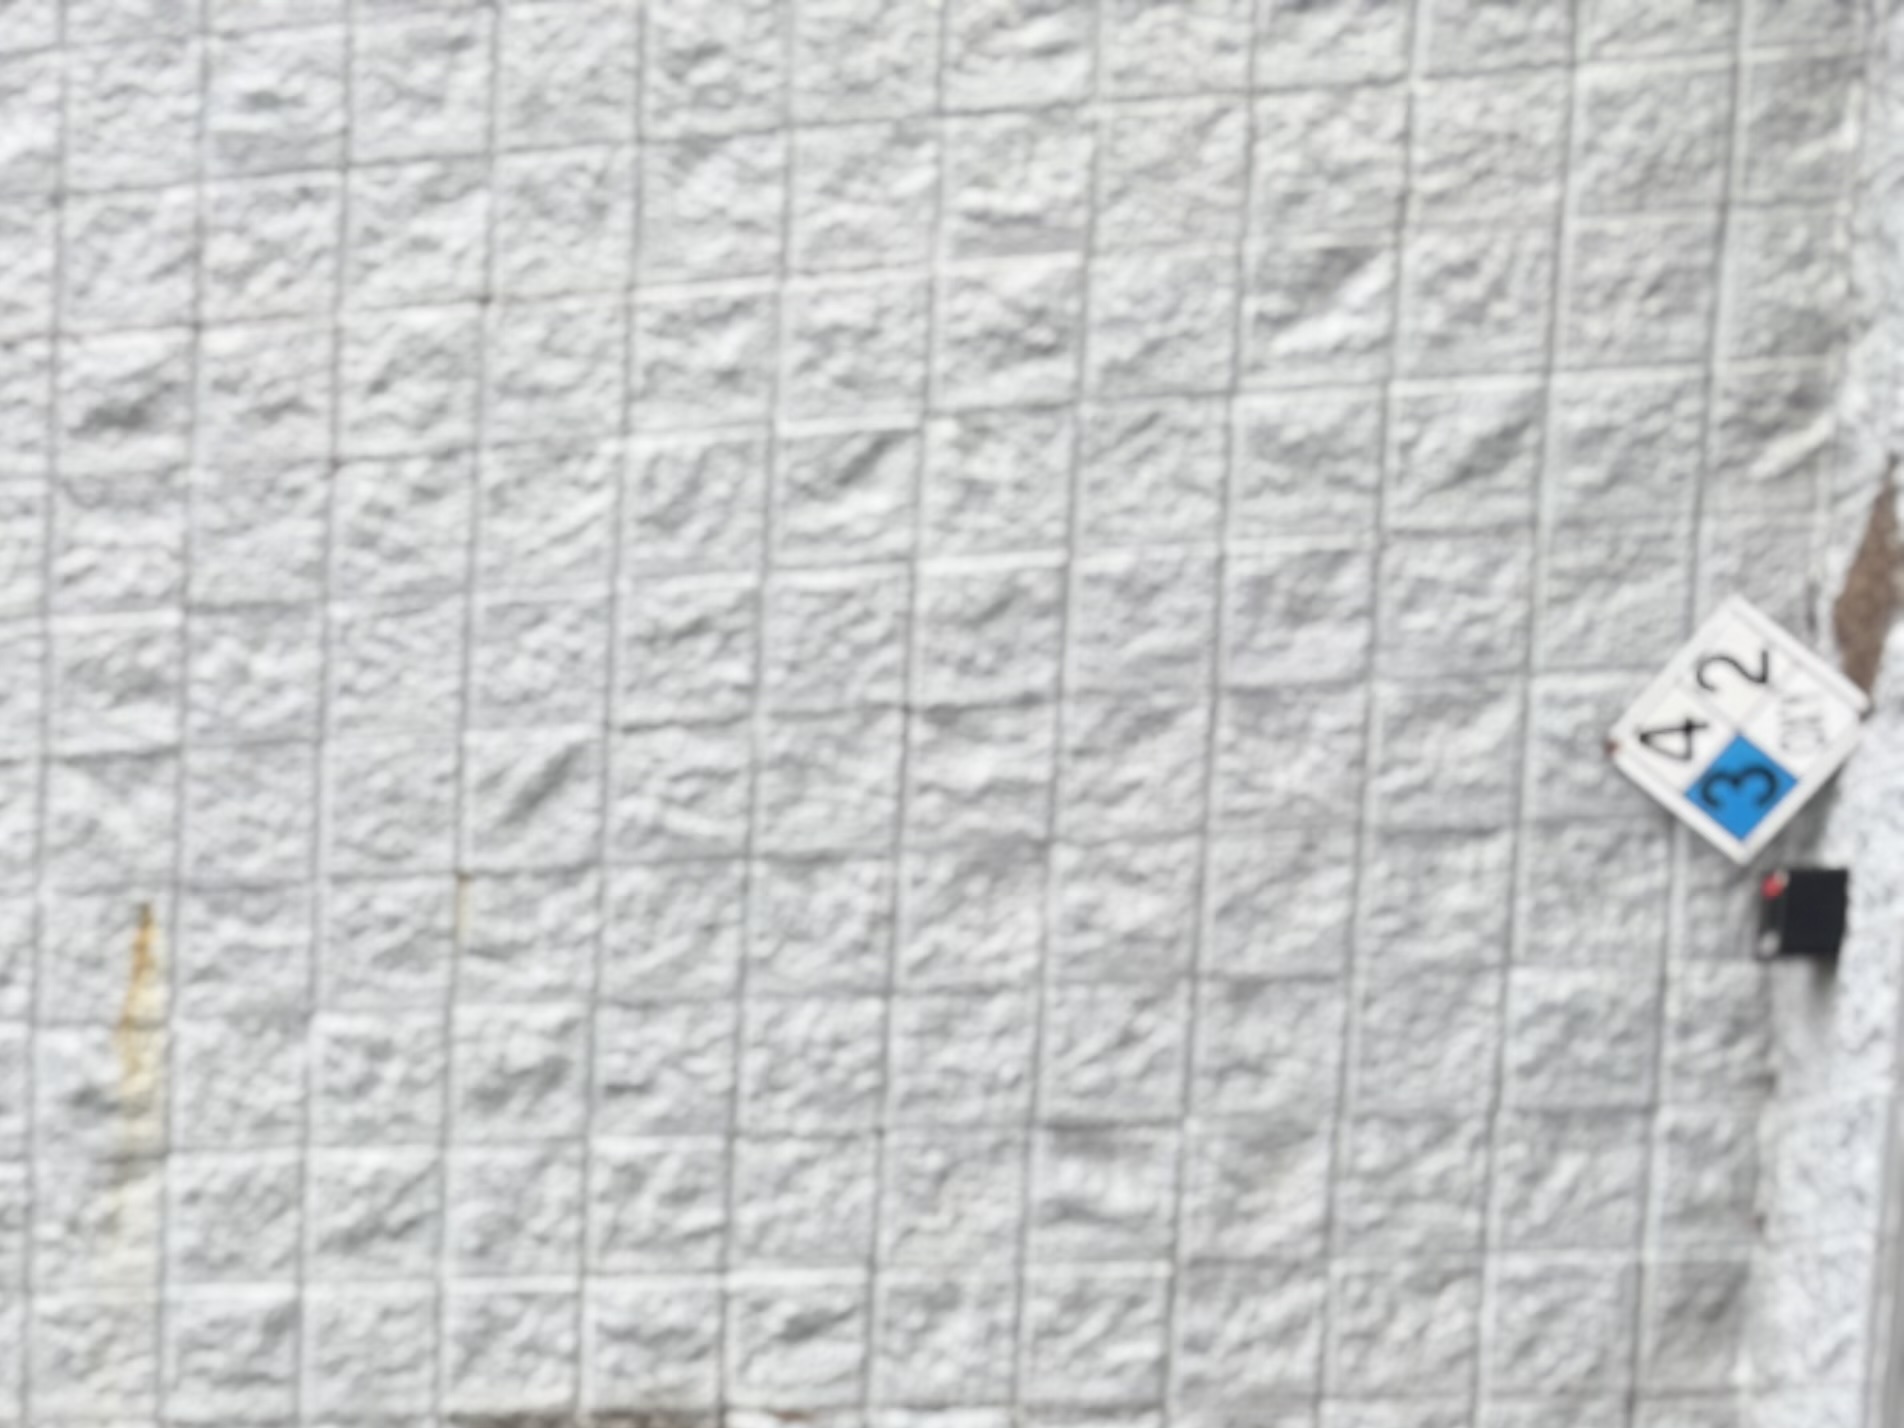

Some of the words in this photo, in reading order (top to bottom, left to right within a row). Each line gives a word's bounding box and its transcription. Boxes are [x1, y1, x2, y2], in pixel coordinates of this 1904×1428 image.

[1696, 647, 1769, 692] 2
[1635, 717, 1709, 762] 4
[1700, 764, 1779, 809] 3
